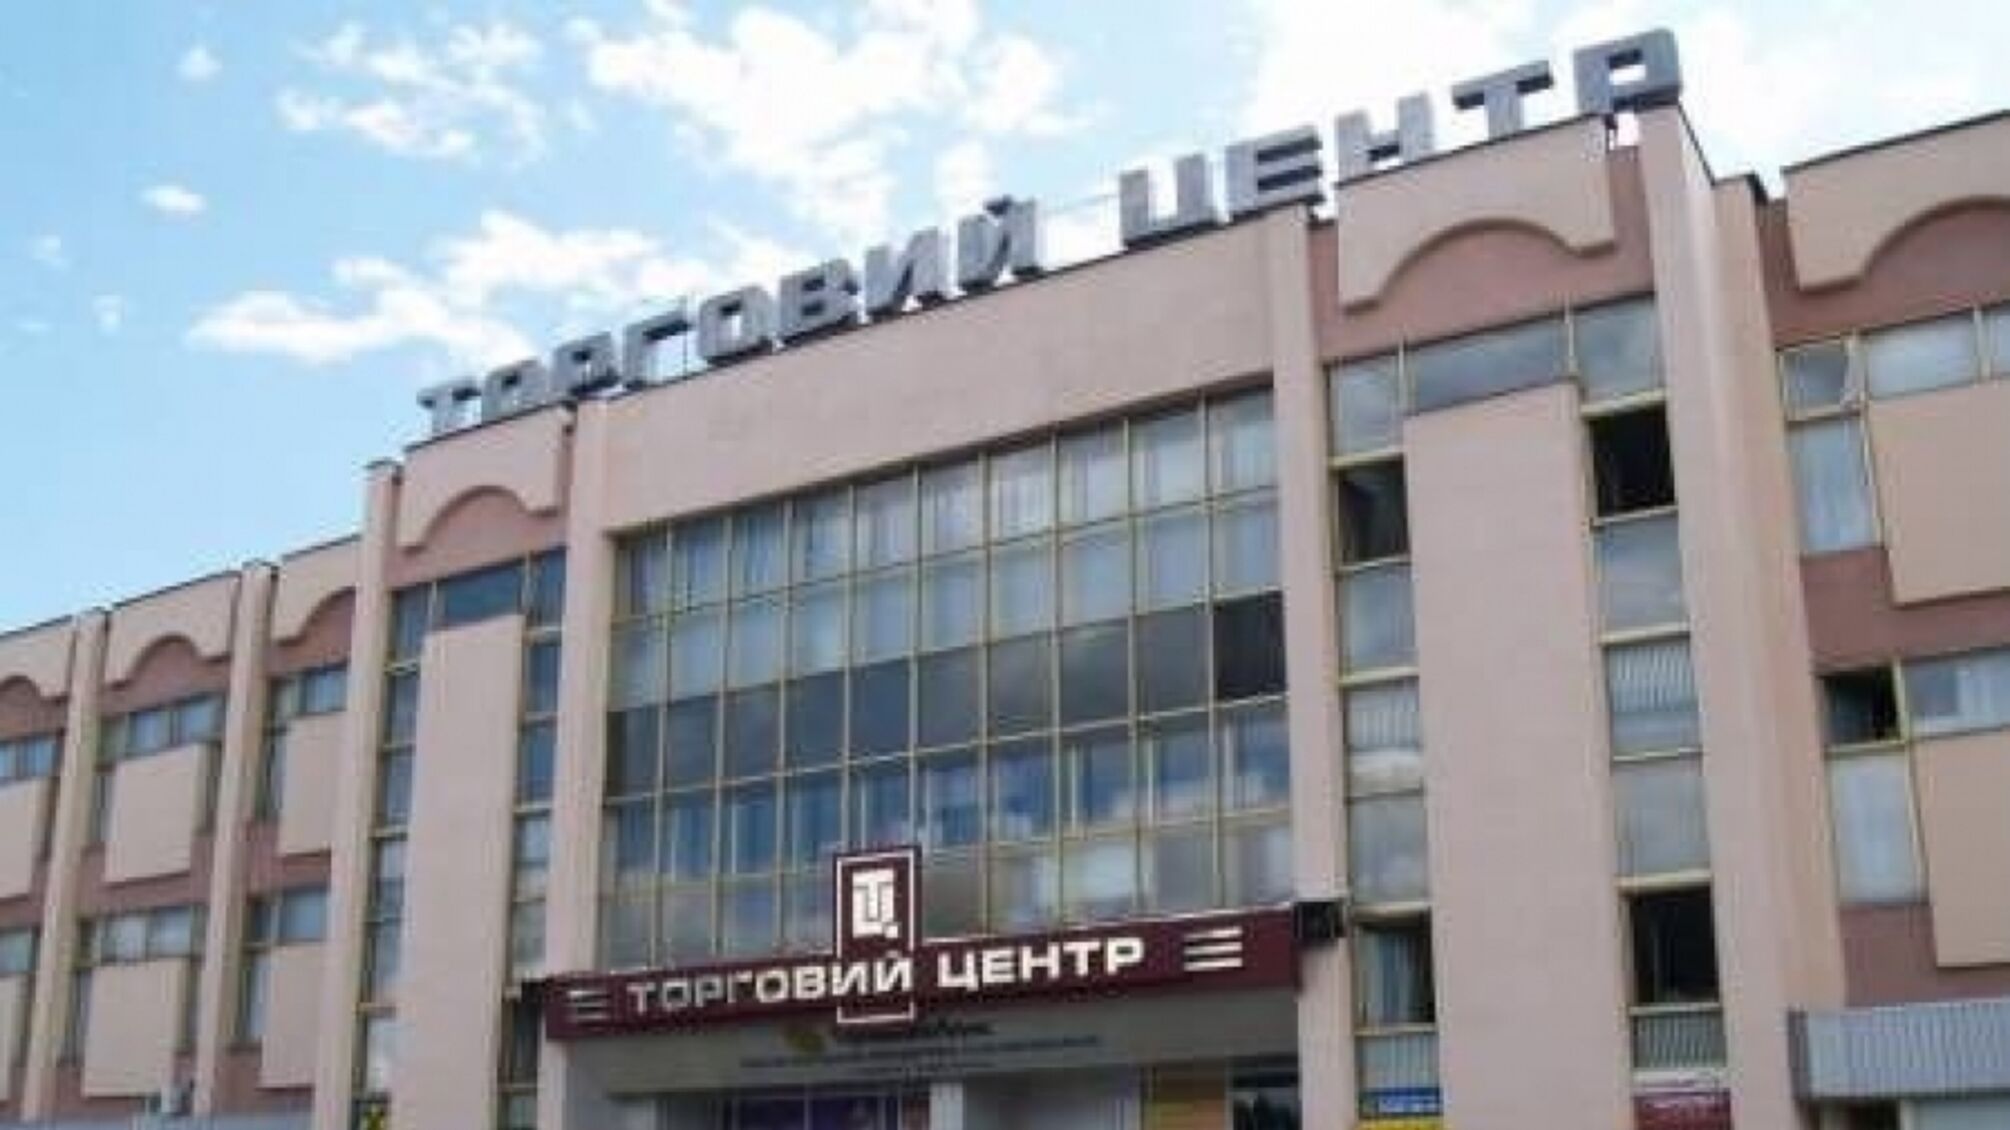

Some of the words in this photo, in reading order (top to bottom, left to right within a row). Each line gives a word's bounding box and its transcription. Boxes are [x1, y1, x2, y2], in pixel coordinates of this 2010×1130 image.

[418, 195, 1043, 434] ТОРГОВИЙ
[1118, 27, 1682, 250] ЦЕНТР
[627, 950, 913, 1012] ТОРГОВИЙ
[938, 937, 1144, 990] ЦЕНТР
